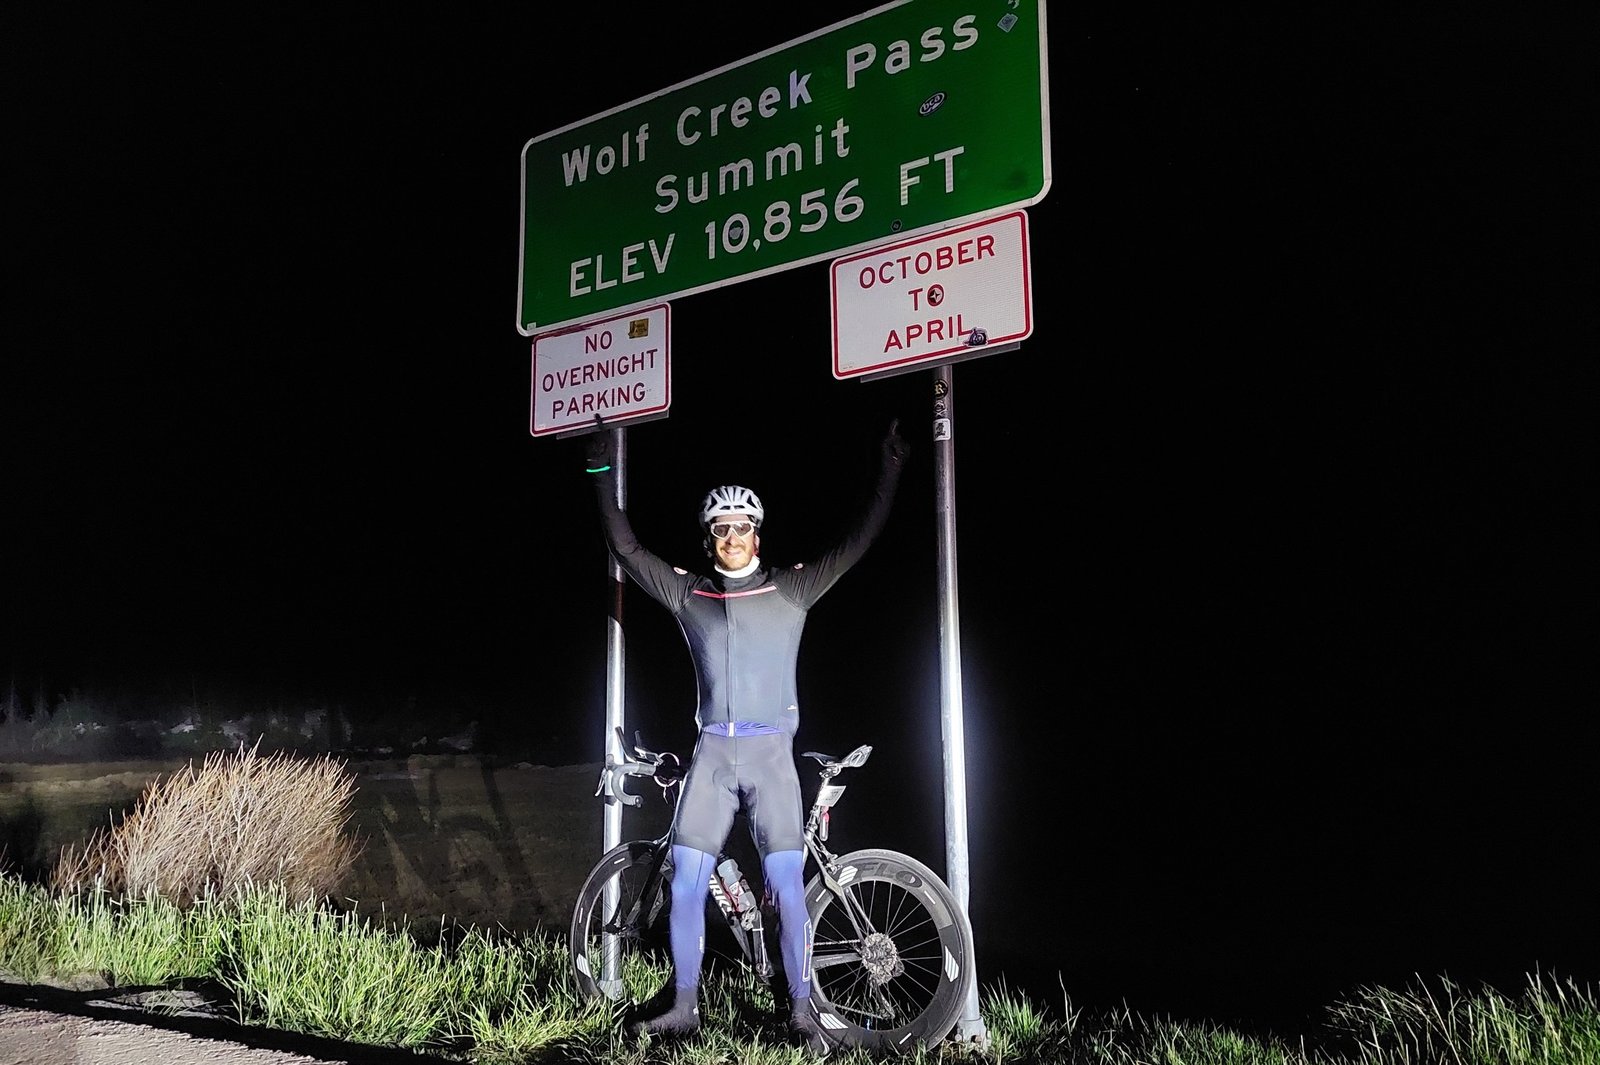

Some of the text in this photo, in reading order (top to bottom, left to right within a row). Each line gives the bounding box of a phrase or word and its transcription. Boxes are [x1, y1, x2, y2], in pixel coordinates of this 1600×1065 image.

[562, 14, 979, 187] Wolf Creek Pass
[923, 95, 941, 111] bca
[654, 117, 850, 214] Summit
[570, 146, 965, 298] ELEV 10,856 FT
[859, 234, 996, 290] OCTOBER
[908, 283, 945, 311] TO
[585, 330, 613, 354] NO
[884, 314, 973, 353] APRIL
[542, 348, 658, 393] OVERNIGHT
[552, 382, 646, 420] PARKING
